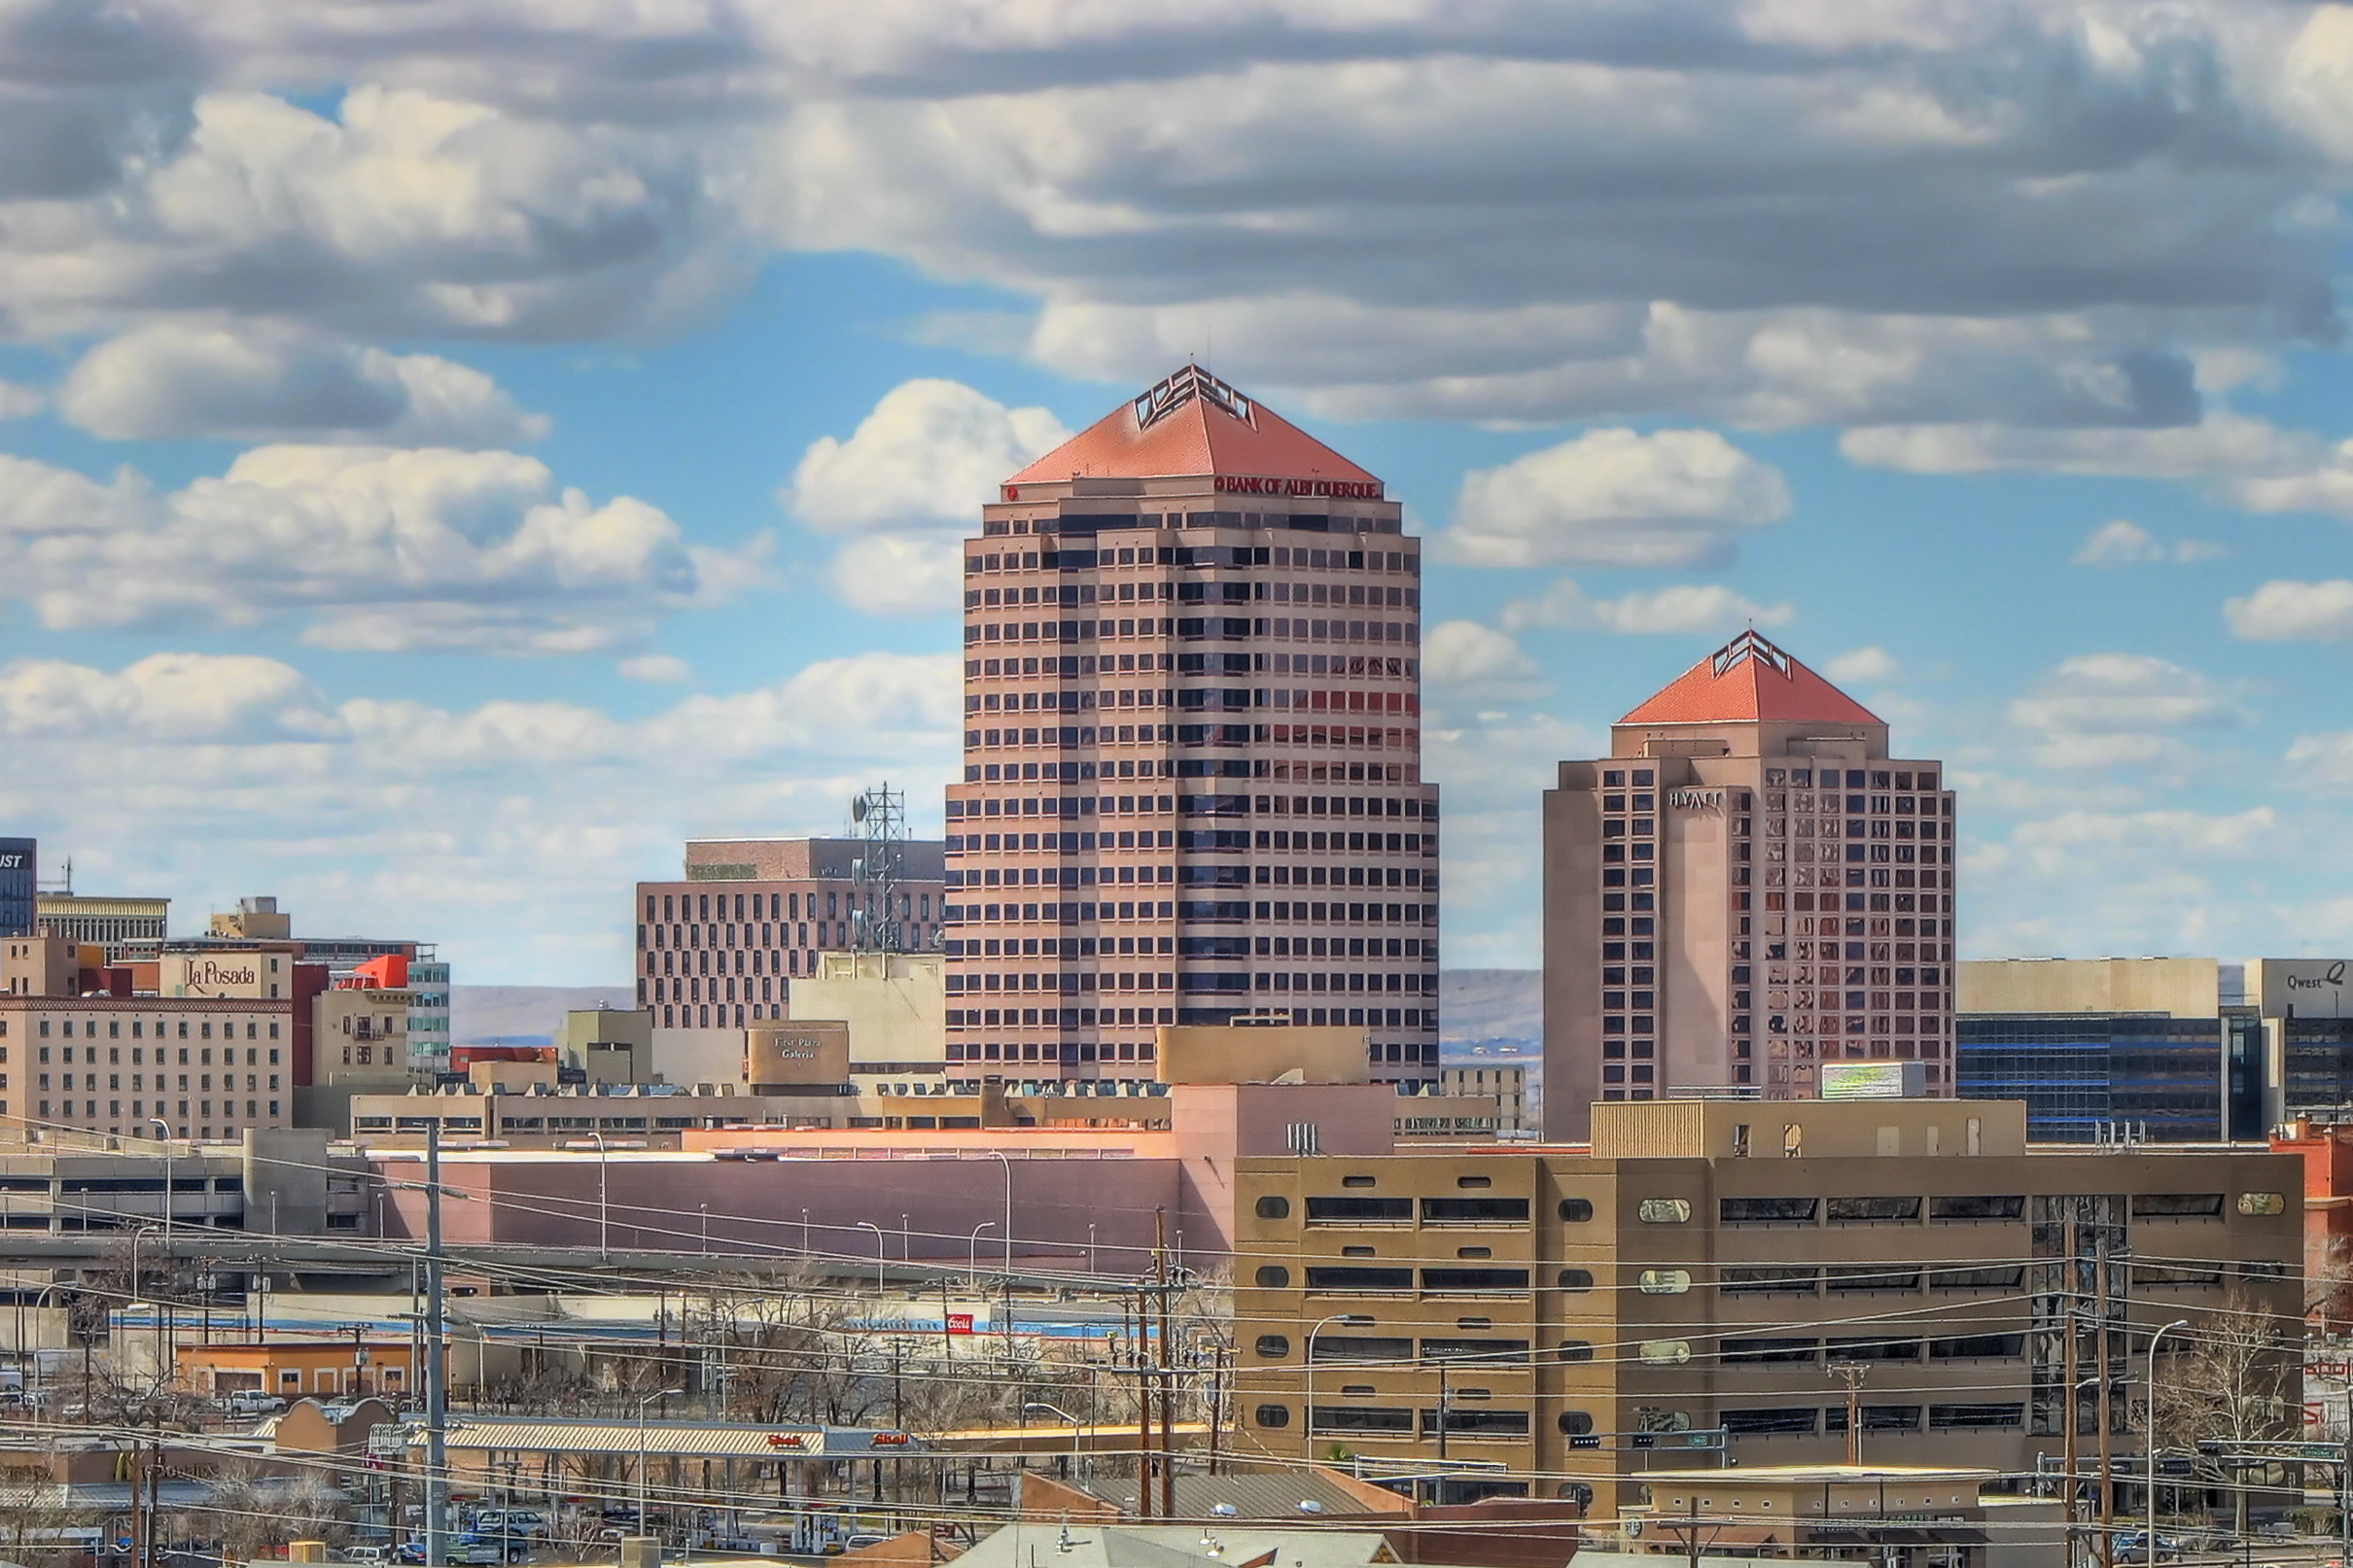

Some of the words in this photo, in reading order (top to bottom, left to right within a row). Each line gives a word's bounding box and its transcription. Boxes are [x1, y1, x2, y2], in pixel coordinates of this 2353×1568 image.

[1226, 475, 1264, 494] BANK
[1265, 477, 1282, 495] OF
[1668, 791, 1722, 810] HYATT
[185, 958, 207, 994] La
[204, 960, 255, 985] Posada
[2287, 975, 2322, 990] Qwest
[874, 1433, 909, 1445] Shell
